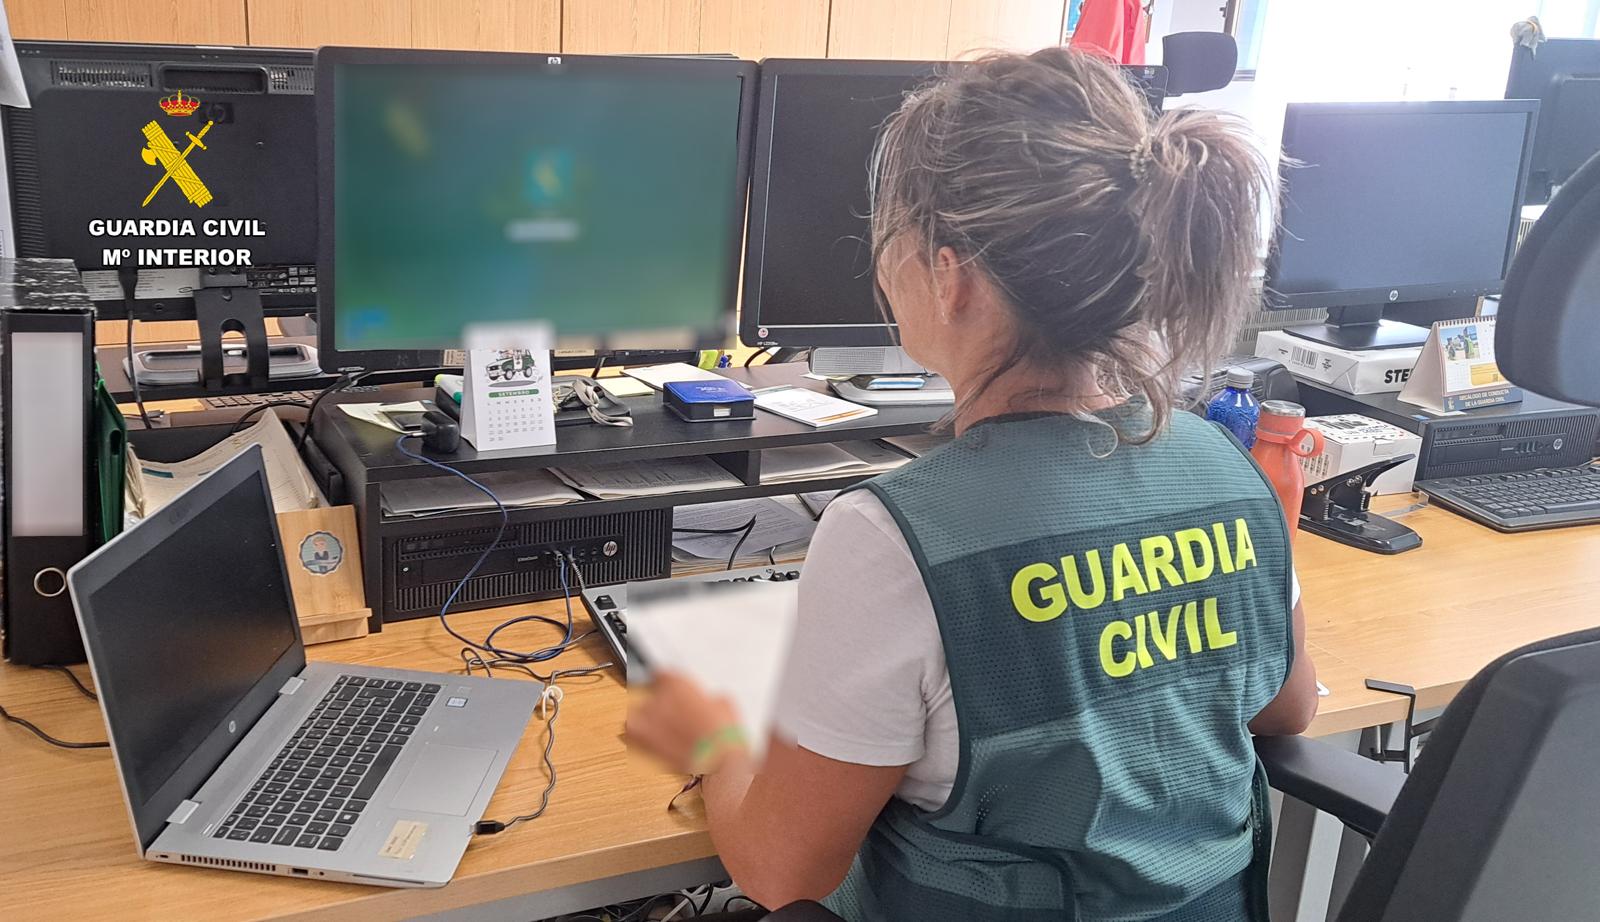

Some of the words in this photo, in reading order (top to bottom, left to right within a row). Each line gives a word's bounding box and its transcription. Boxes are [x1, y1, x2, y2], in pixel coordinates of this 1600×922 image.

[1383, 368, 1414, 384] STE
[603, 540, 618, 557] hp
[1011, 518, 1257, 622] GUARDIA
[1098, 597, 1238, 678] CIVIL
